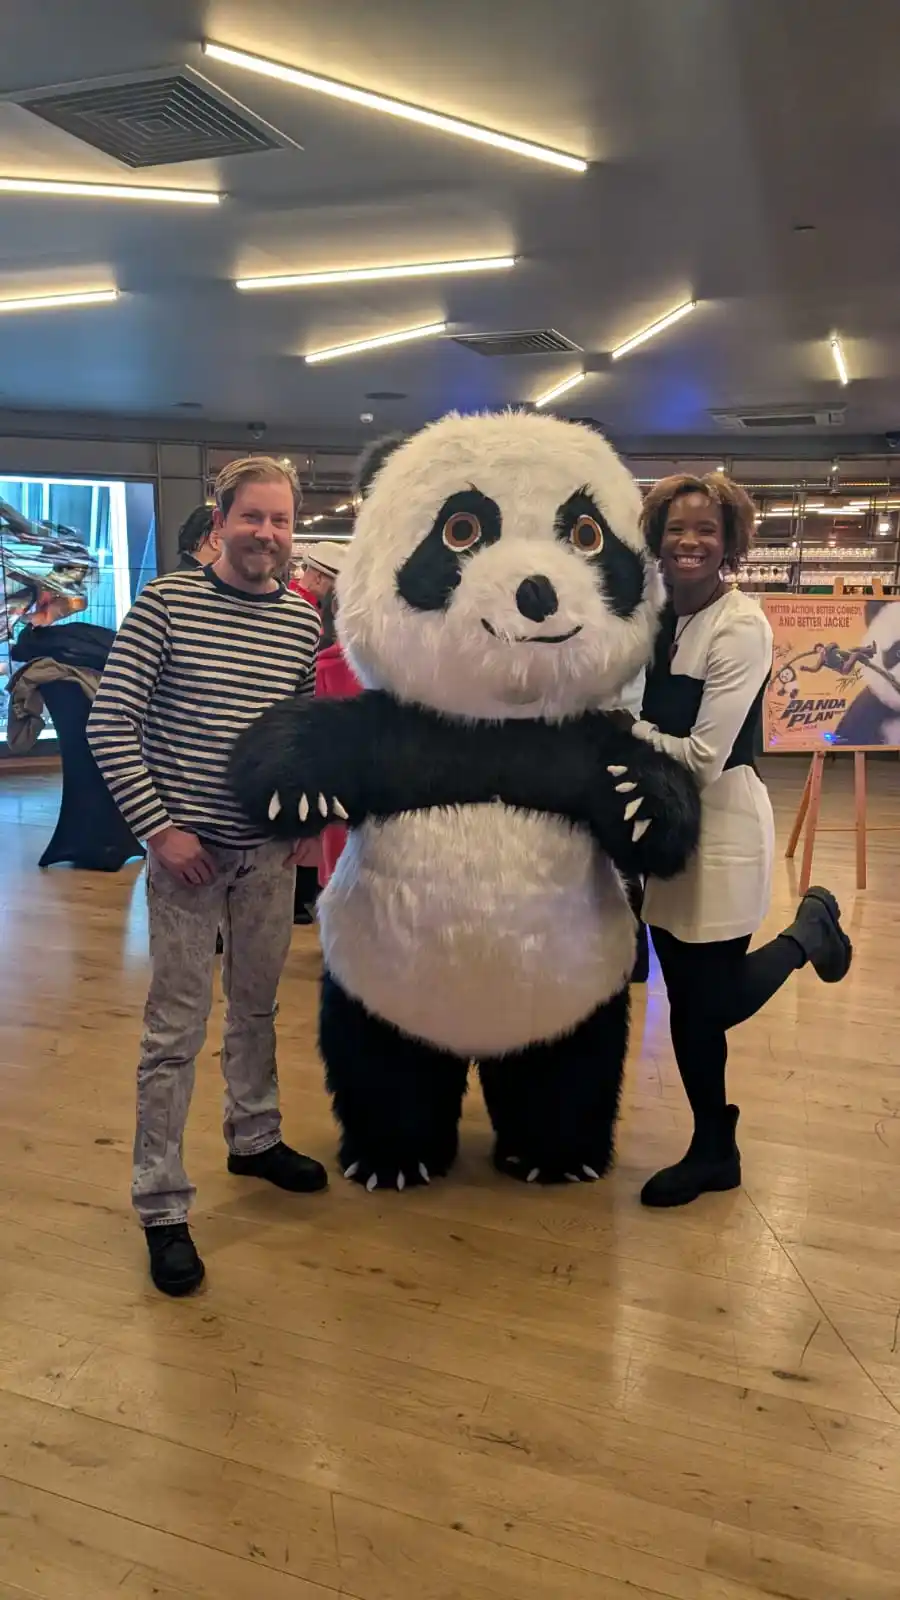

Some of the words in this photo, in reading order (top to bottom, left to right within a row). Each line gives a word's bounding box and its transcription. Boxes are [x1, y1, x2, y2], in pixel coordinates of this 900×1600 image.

[816, 605, 835, 614] BETTER
[778, 616, 796, 627] AND
[797, 616, 822, 627] BETTER
[781, 699, 846, 720] PANDA
[786, 711, 834, 728] PLAN
